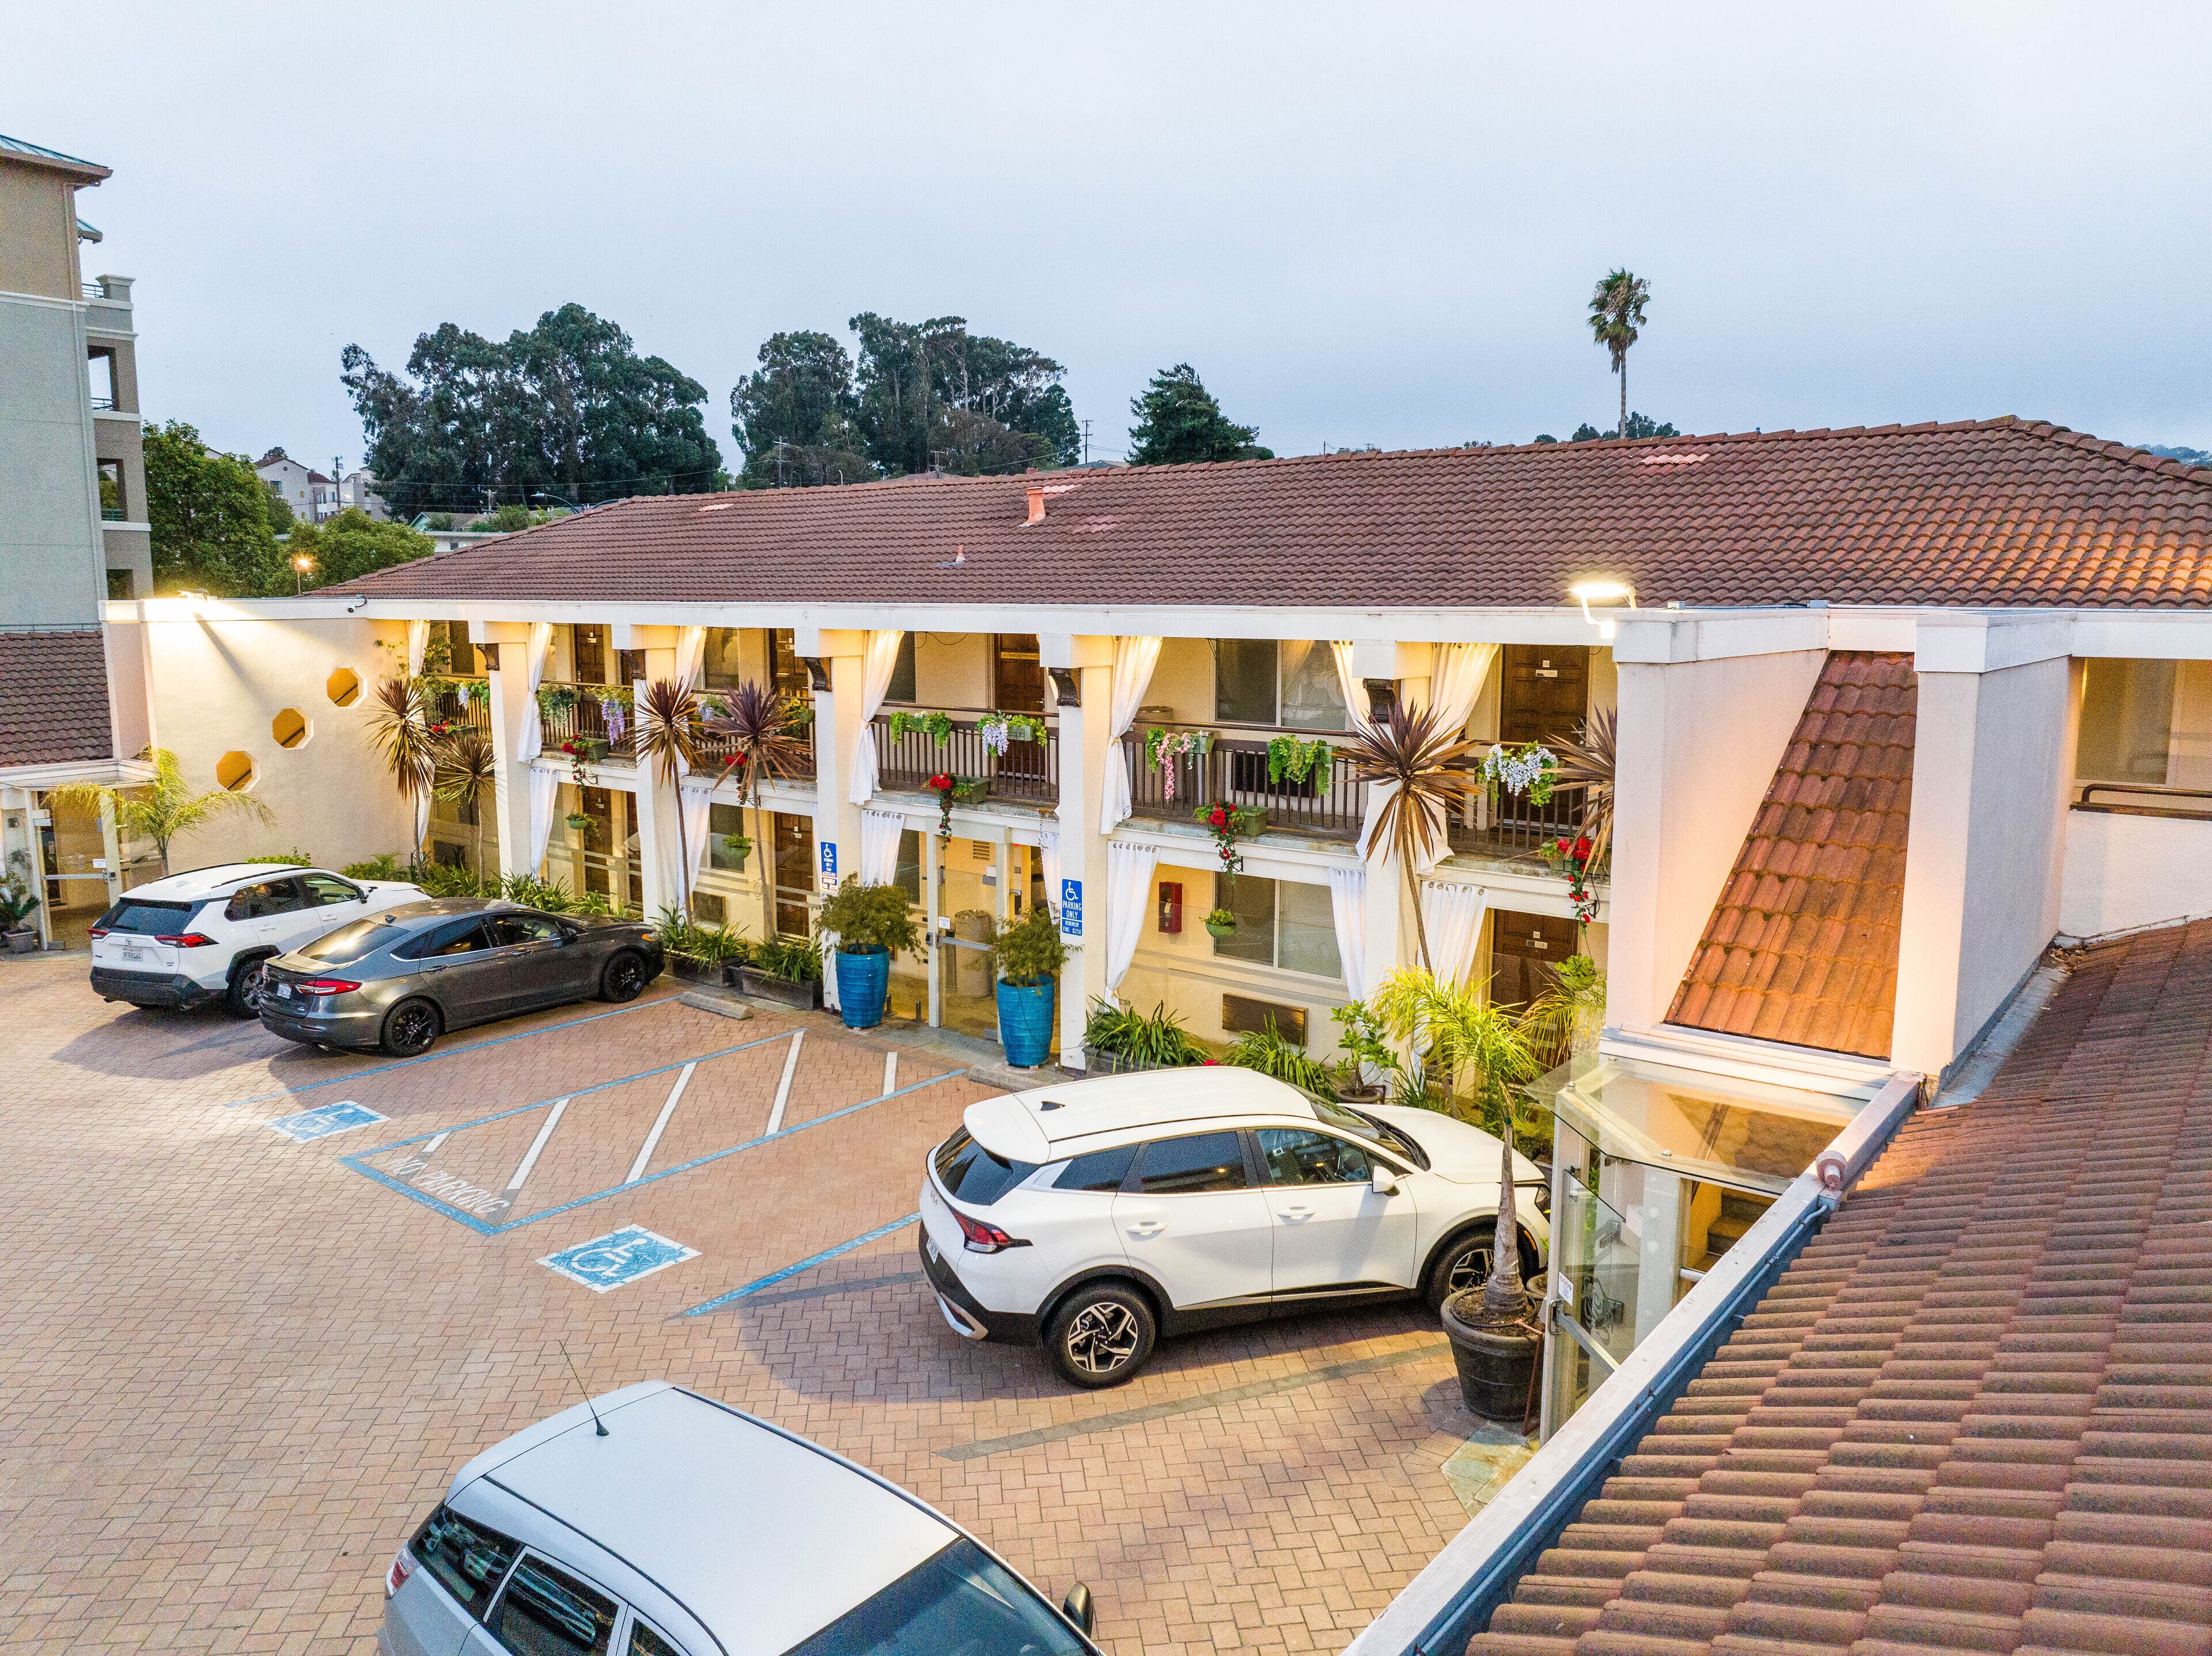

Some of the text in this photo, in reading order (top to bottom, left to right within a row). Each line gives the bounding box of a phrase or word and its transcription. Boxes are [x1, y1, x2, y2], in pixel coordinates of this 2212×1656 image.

[1063, 900, 1081, 911] PARKING
[1066, 910, 1078, 919] ONLY
[382, 1156, 510, 1214] NO PARKING
